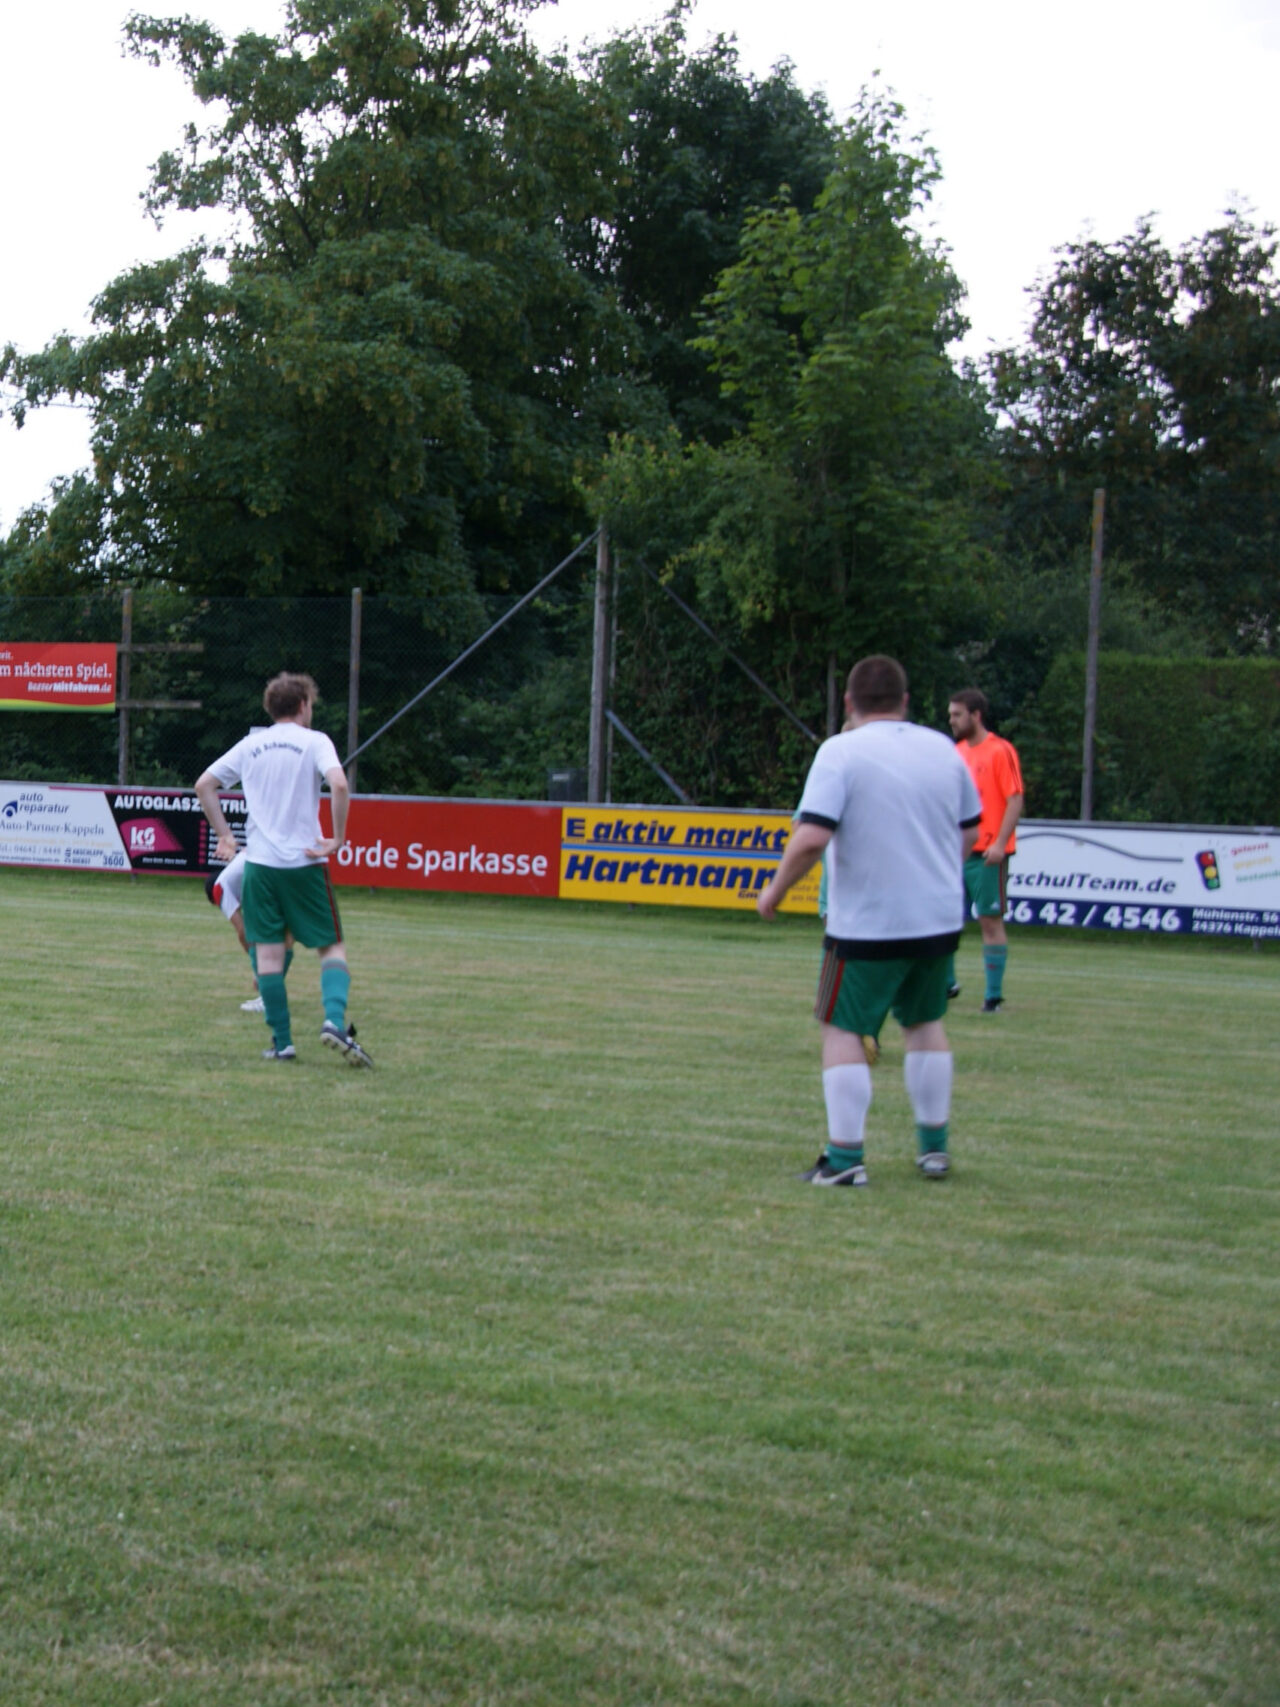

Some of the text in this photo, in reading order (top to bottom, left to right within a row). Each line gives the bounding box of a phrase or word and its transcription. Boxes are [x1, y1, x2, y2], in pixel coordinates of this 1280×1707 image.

[14, 662, 73, 678] nächsten
[77, 662, 112, 681] Spiel.
[19, 792, 44, 801] auto
[19, 803, 69, 814] reparatur
[0, 820, 105, 837] Auto-Partner-Kappeln
[567, 818, 790, 849] E aktiv markt
[334, 839, 549, 878] örde Sparkasse
[738, 889, 761, 900] Gm
[1039, 902, 1077, 926] 42
[1081, 904, 1098, 927] /
[1103, 905, 1181, 932] 4546
[1191, 920, 1232, 933] 24376
